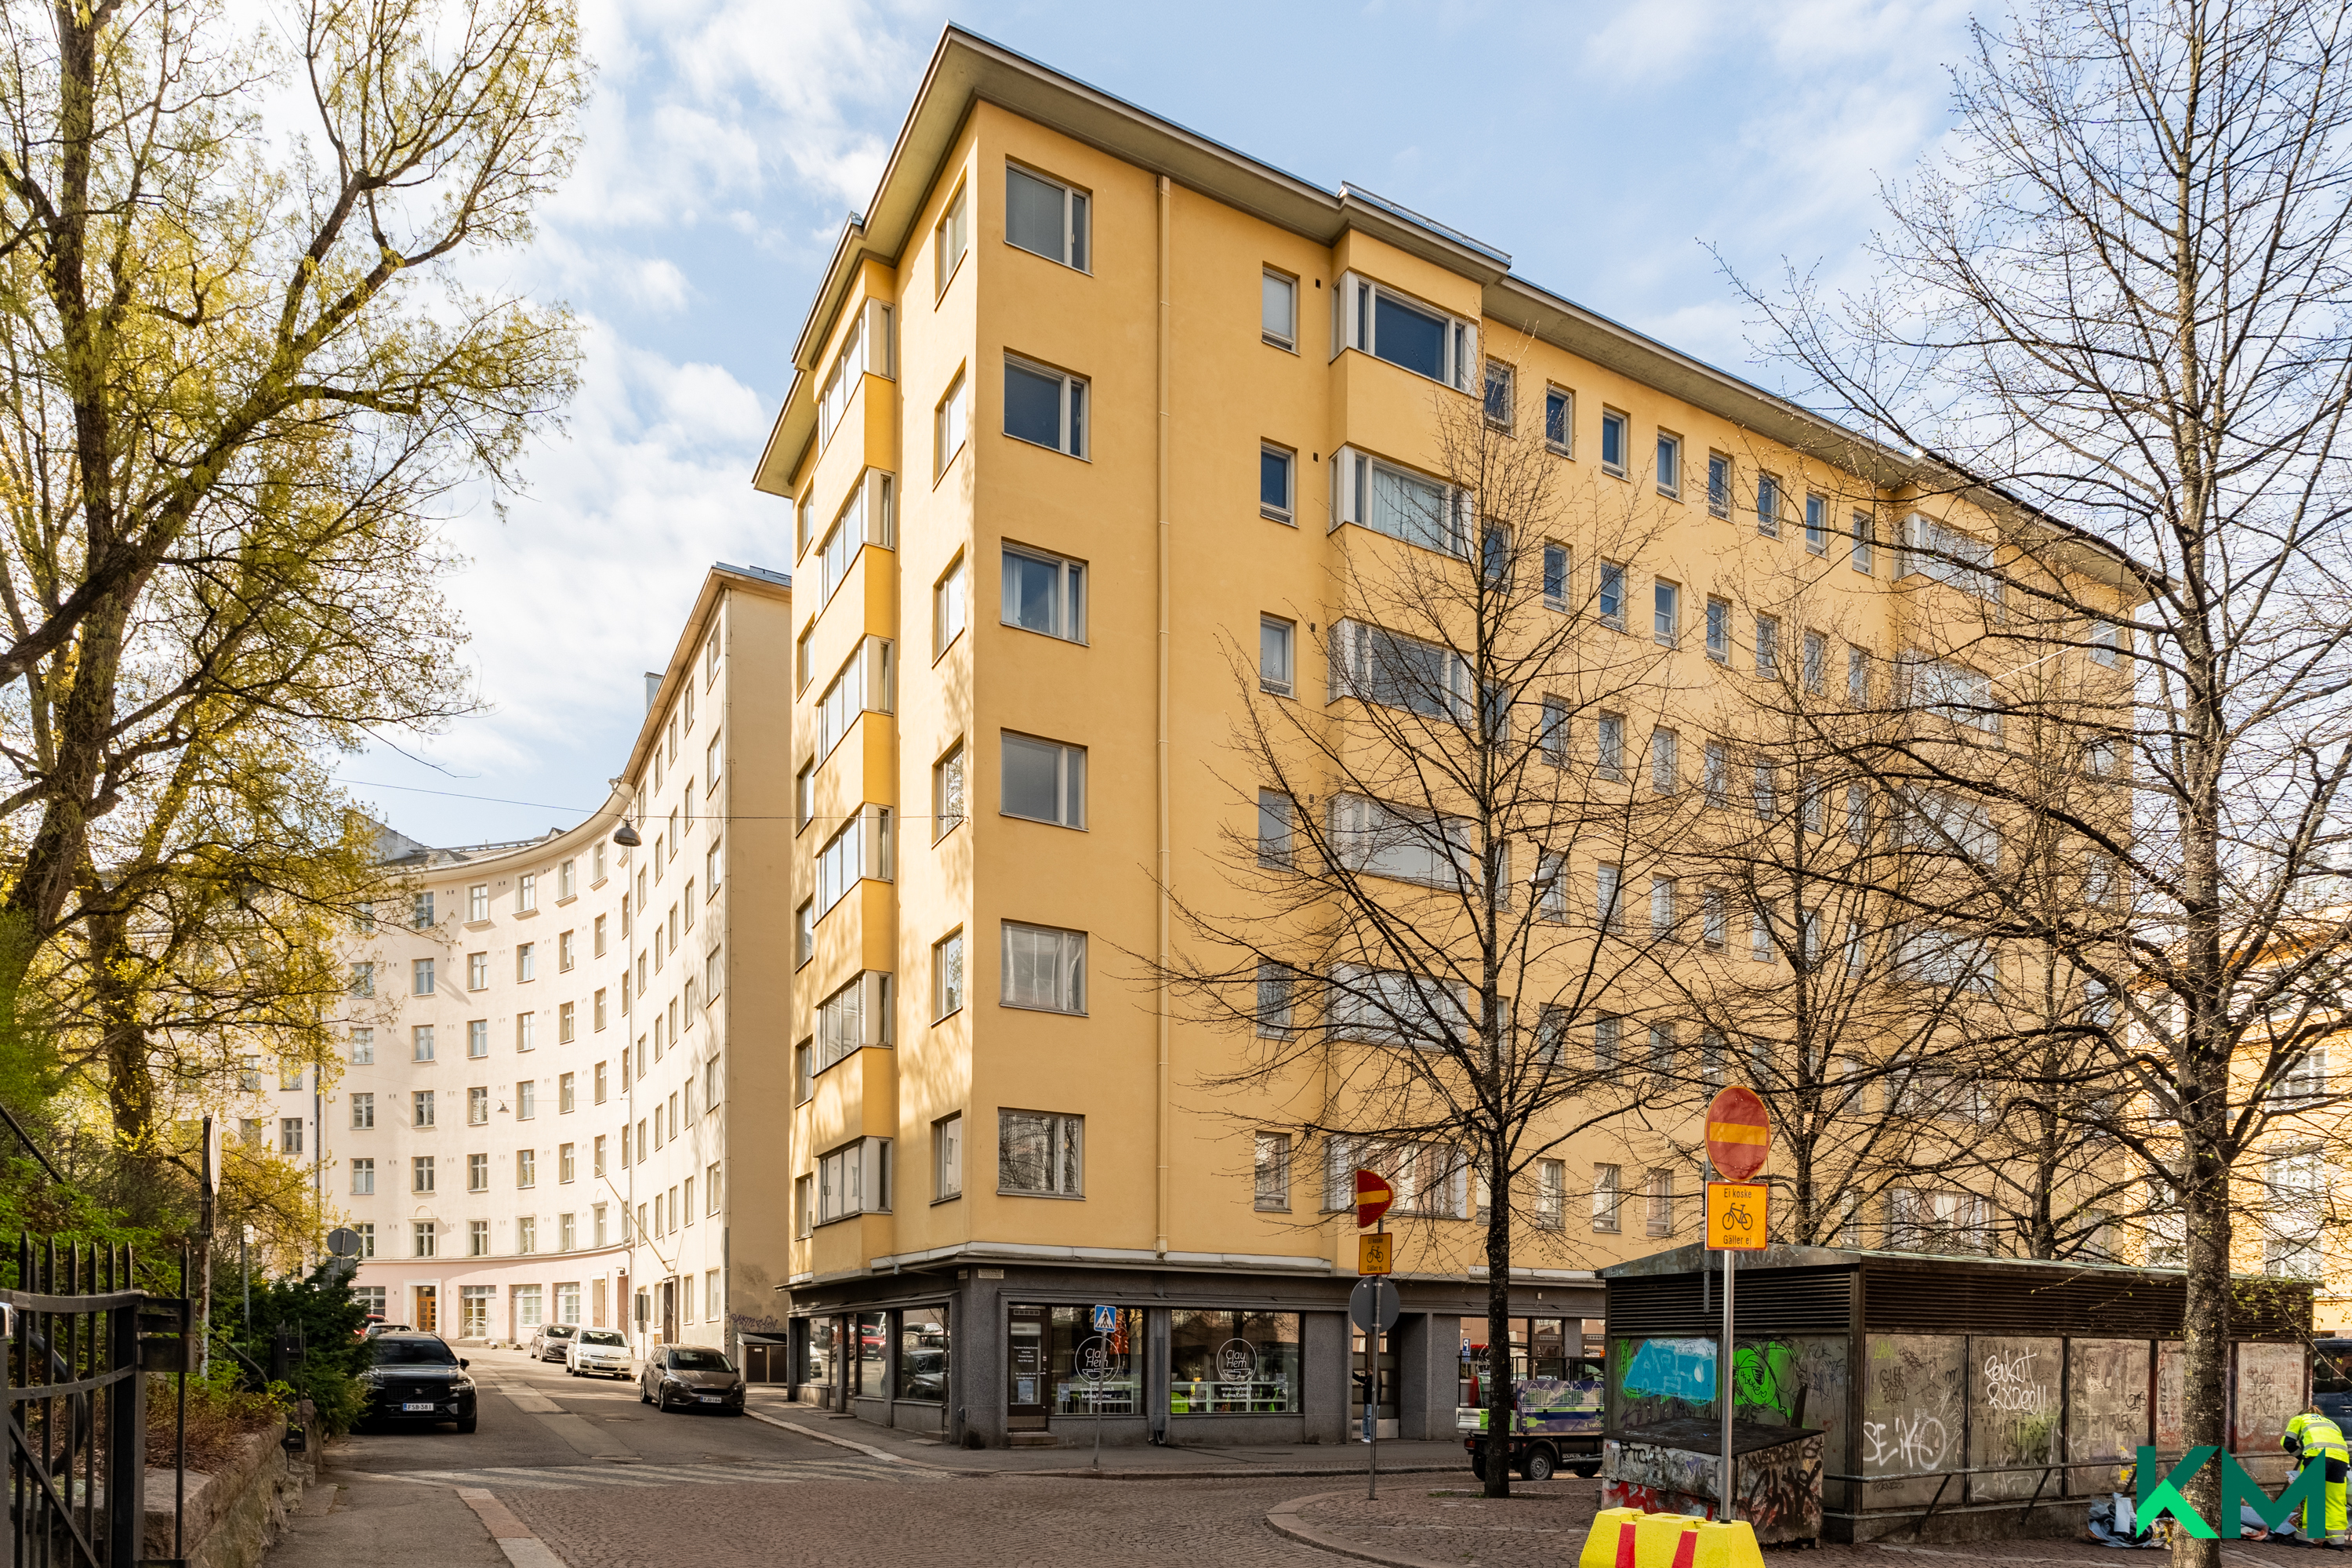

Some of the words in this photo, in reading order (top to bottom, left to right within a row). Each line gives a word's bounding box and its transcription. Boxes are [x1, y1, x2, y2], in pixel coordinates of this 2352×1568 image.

[1724, 1189, 1730, 1198] Ei
[1732, 1188, 1751, 1199] koske
[1723, 1235, 1743, 1245] Gäller
[1745, 1236, 1751, 1246] ej
[1225, 1349, 1246, 1361] Clay
[1226, 1359, 1247, 1368] Hem
